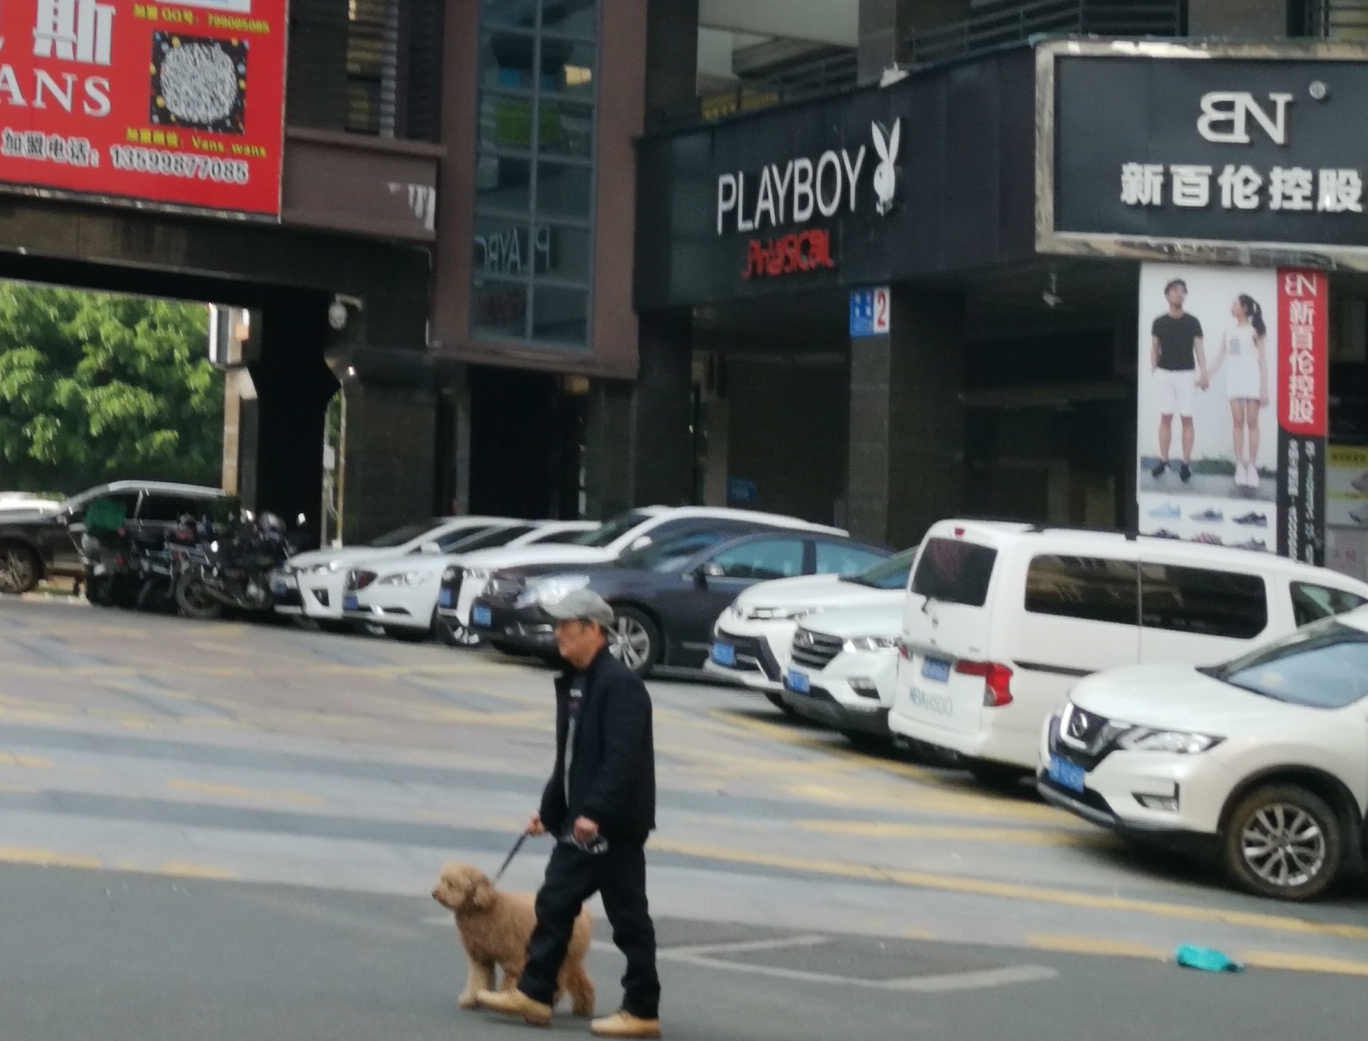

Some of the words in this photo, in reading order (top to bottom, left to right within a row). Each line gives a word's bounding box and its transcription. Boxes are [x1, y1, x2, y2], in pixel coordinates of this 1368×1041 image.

[716, 144, 867, 237] PLAYBOY
[1120, 161, 1364, 213] 新百伦控股
[876, 290, 887, 329] 2
[1288, 299, 1315, 424] 新百伦控股
